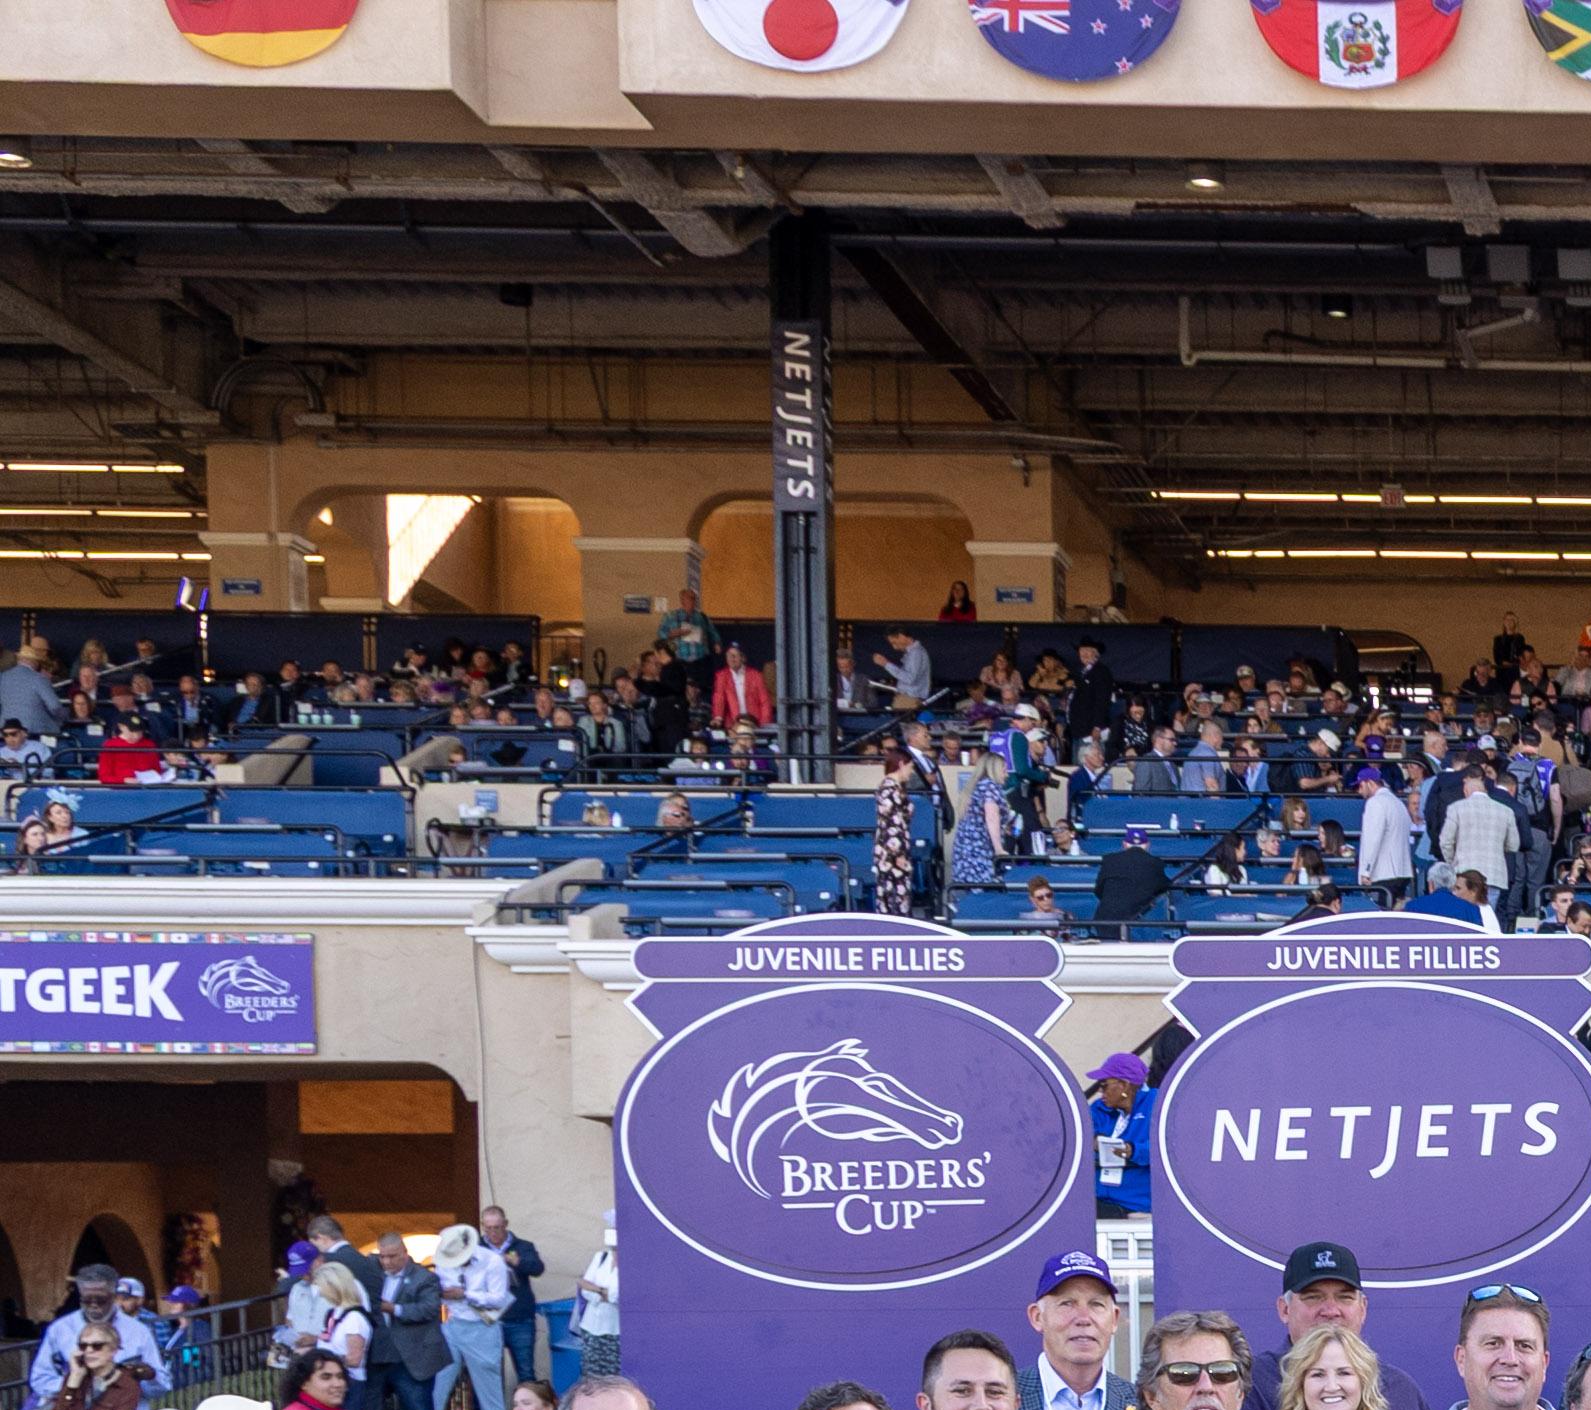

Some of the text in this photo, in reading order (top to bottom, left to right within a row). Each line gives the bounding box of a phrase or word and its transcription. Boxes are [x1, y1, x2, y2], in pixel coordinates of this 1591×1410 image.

[776, 331, 815, 499] NETJETS
[728, 946, 965, 972] JUVENILE FILLIES
[1266, 945, 1501, 971] JUVENILE FILLIES
[224, 993, 300, 1009] BREEDERS'
[243, 1007, 275, 1022] CUP
[1210, 1101, 1560, 1179] NETJETS
[779, 1152, 992, 1198] BREEDERS'
[835, 1194, 924, 1235] CUP
